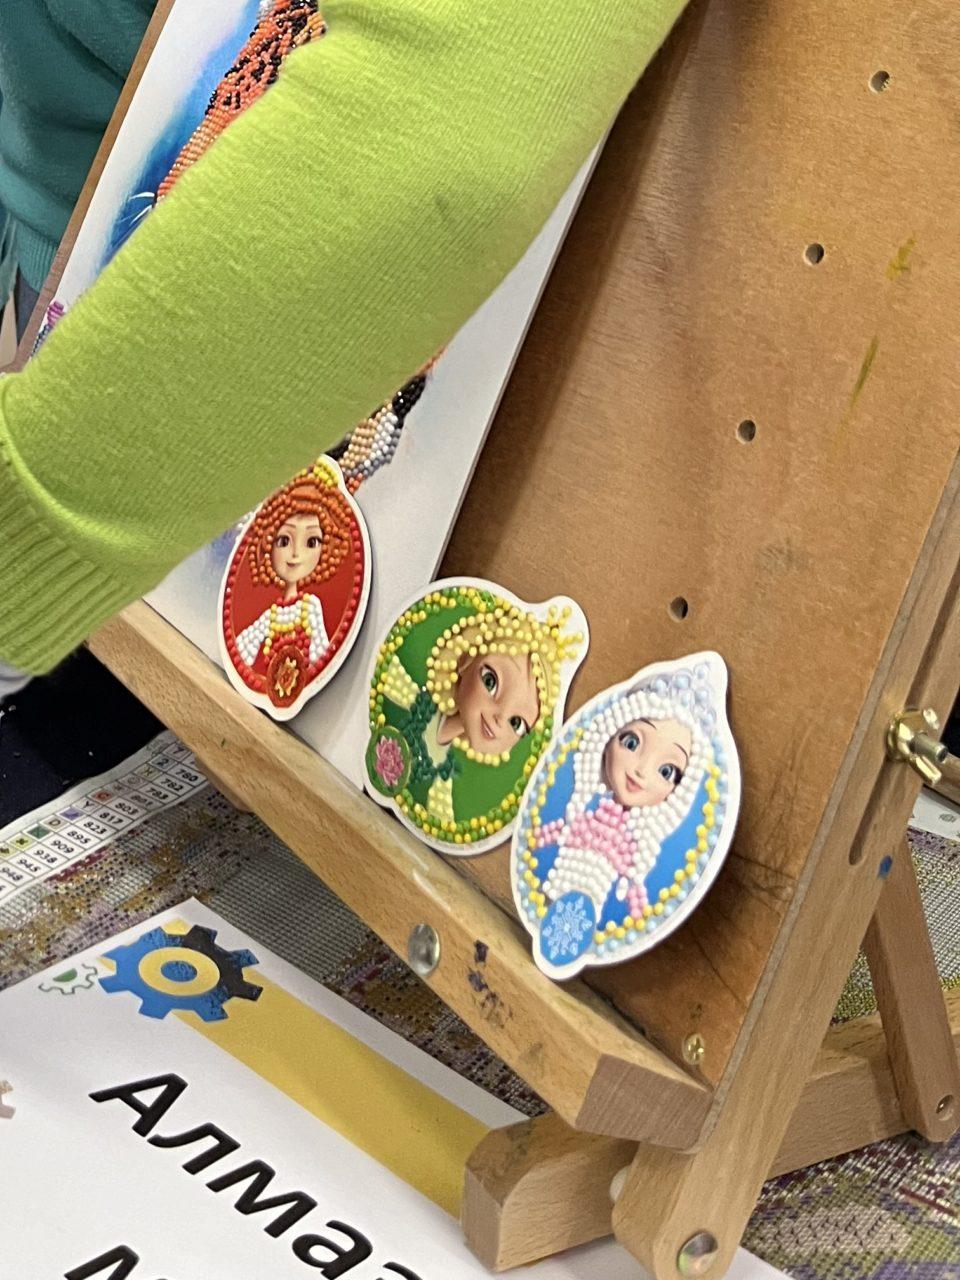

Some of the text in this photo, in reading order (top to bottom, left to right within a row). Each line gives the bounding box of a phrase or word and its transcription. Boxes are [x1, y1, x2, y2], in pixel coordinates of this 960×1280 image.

[175, 769, 198, 782] 780
[99, 812, 124, 825] 817
[83, 821, 107, 835] 823
[67, 831, 91, 844] 895
[51, 840, 75, 854] 909
[34, 849, 58, 863] 938
[17, 859, 41, 873] 945
